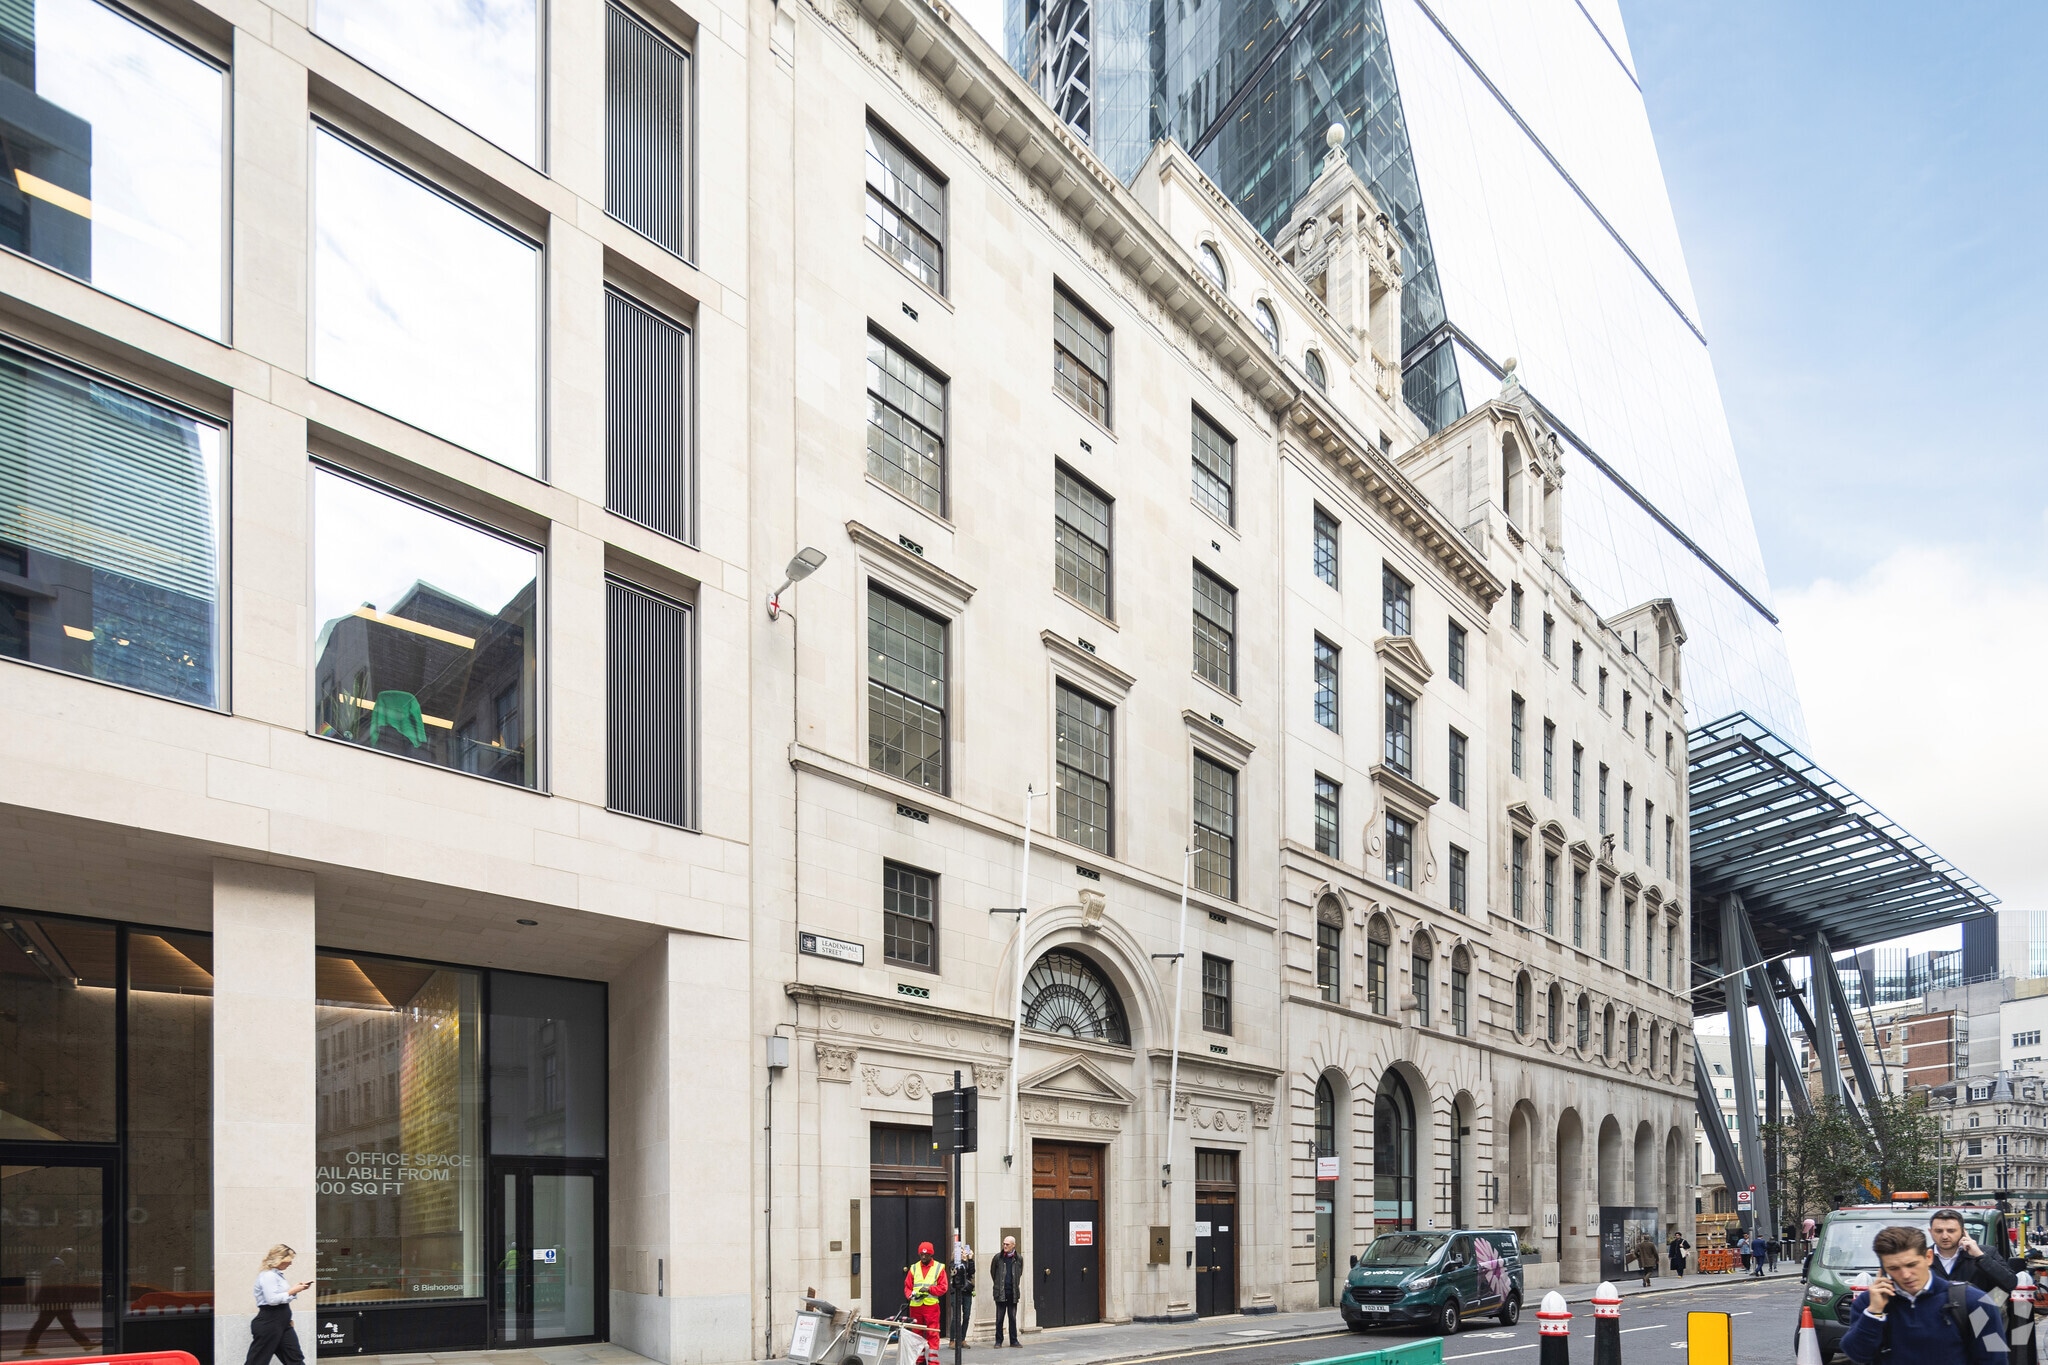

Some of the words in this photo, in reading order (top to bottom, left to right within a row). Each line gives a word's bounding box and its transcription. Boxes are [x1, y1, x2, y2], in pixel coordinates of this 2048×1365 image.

[821, 940, 858, 953] LEADENHALL
[821, 946, 842, 957] STREET
[1066, 1110, 1081, 1120] 147
[345, 1151, 410, 1166] OFFICE
[415, 1153, 472, 1167] SPACE
[398, 1168, 450, 1181] FROM
[350, 1182, 378, 1195] SQ
[382, 1183, 405, 1195] FT
[1545, 1214, 1557, 1227] 140
[1588, 1213, 1599, 1227] 140
[413, 1284, 420, 1292] 8
[848, 1336, 856, 1344] 25
